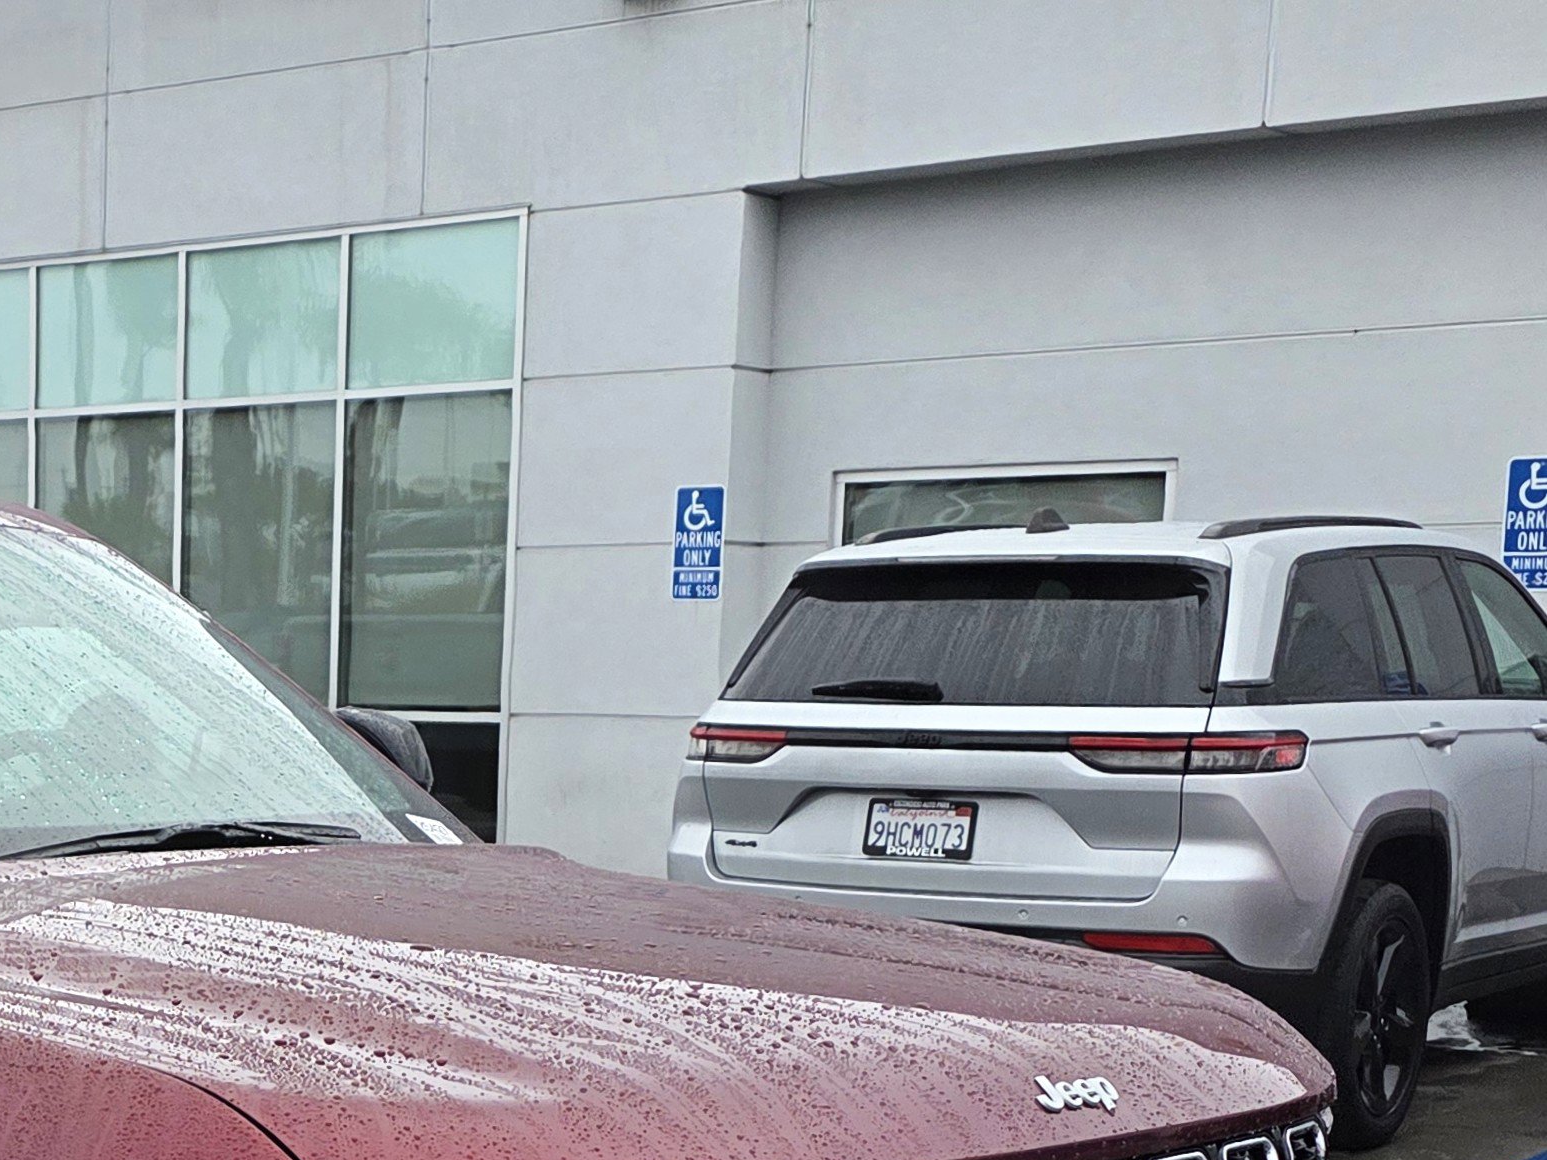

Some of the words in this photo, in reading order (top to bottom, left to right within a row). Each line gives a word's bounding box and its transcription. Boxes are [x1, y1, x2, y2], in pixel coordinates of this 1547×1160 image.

[1507, 510, 1547, 530] PARK
[675, 531, 721, 548] PARKING
[1517, 531, 1547, 551] ONL
[683, 549, 712, 566] ONLY
[679, 572, 715, 583] MINIMUM
[695, 585, 718, 597] $250
[870, 820, 965, 849] 9HCM073
[886, 846, 946, 857] POWELL
[1034, 1075, 1120, 1112] Jeep
